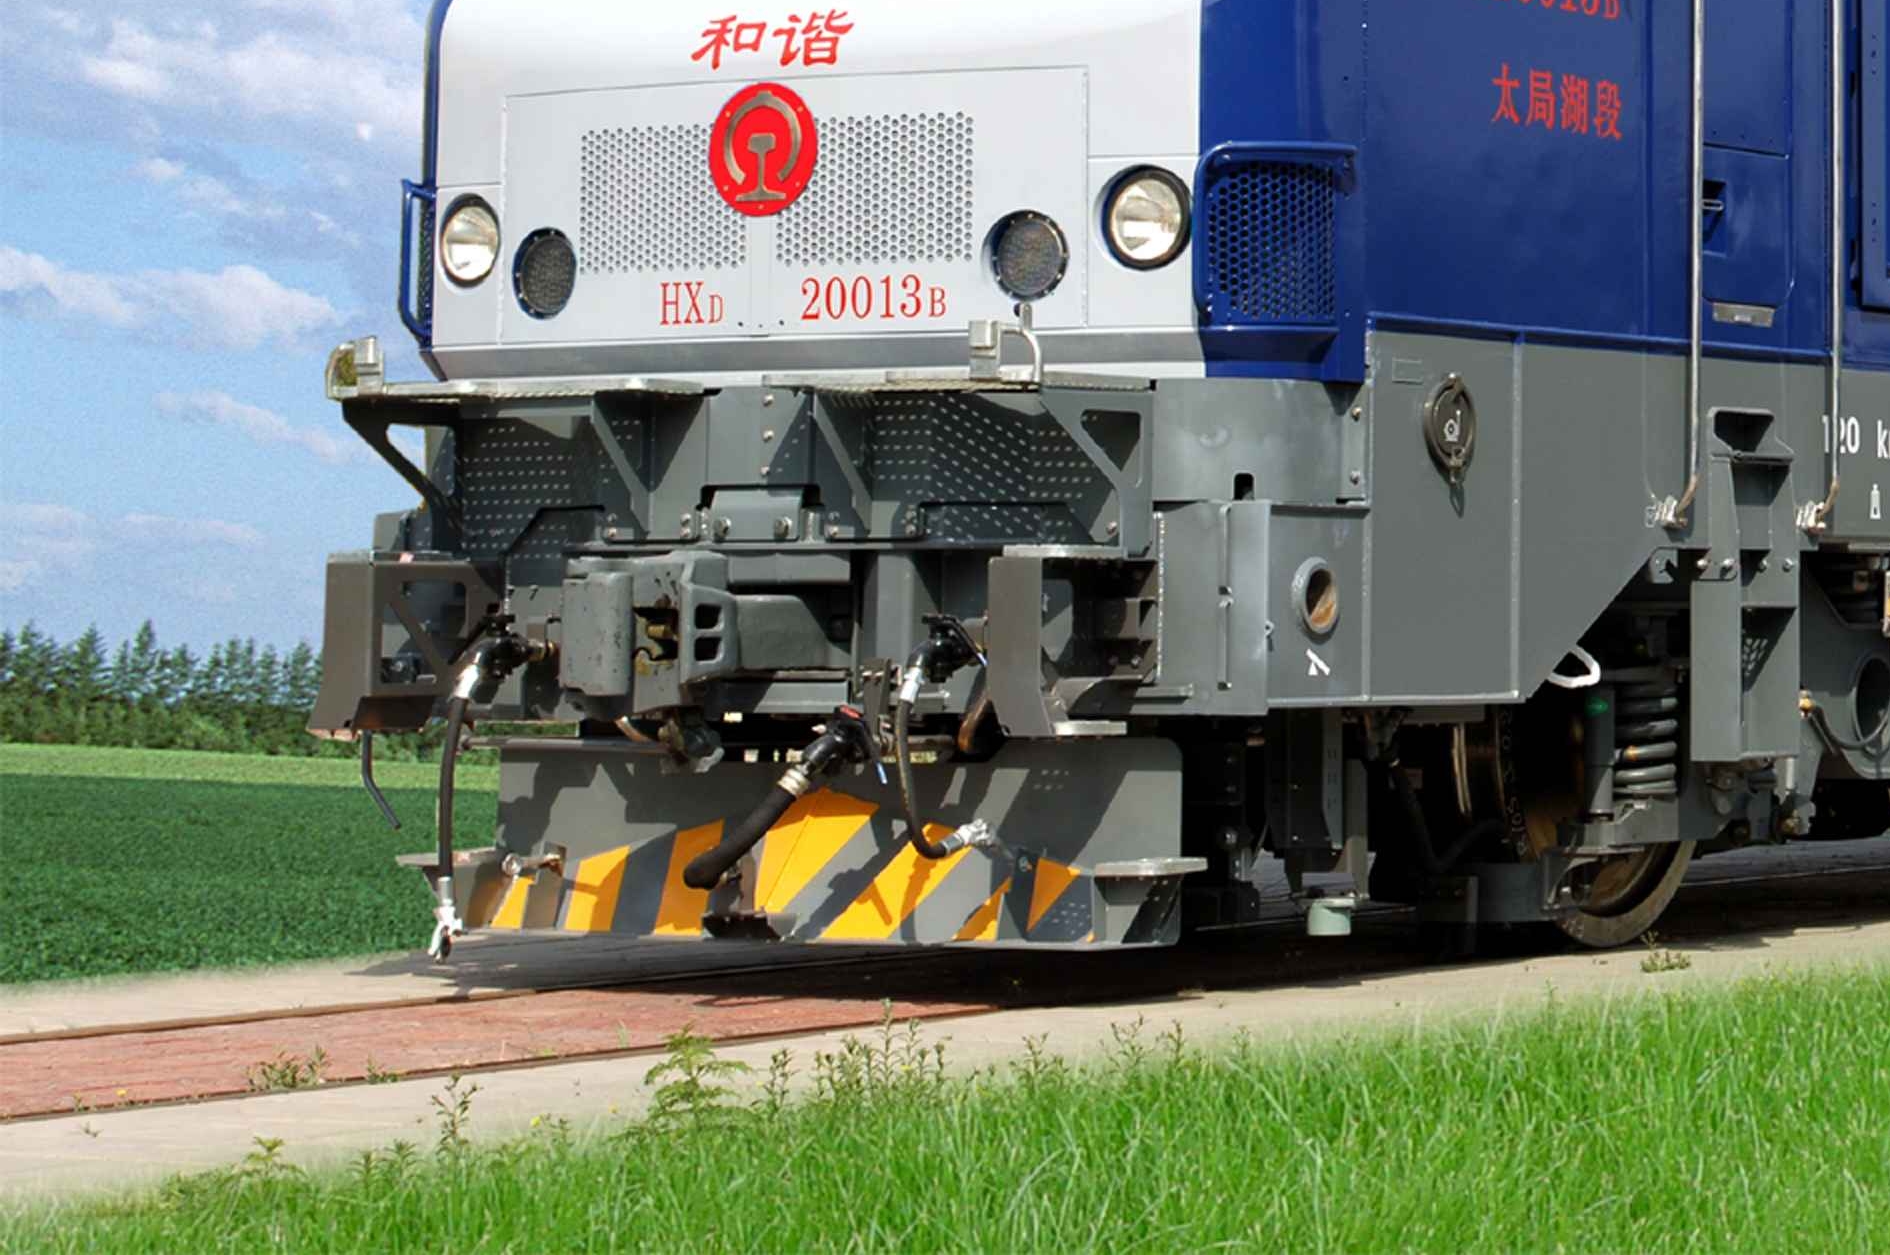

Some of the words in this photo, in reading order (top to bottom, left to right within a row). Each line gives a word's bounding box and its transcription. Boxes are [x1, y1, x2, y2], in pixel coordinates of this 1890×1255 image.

[690, 8, 854, 71] 和谐
[1491, 63, 1623, 140] 太局湖段
[660, 280, 724, 327] HXD
[800, 274, 947, 322] 20013B
